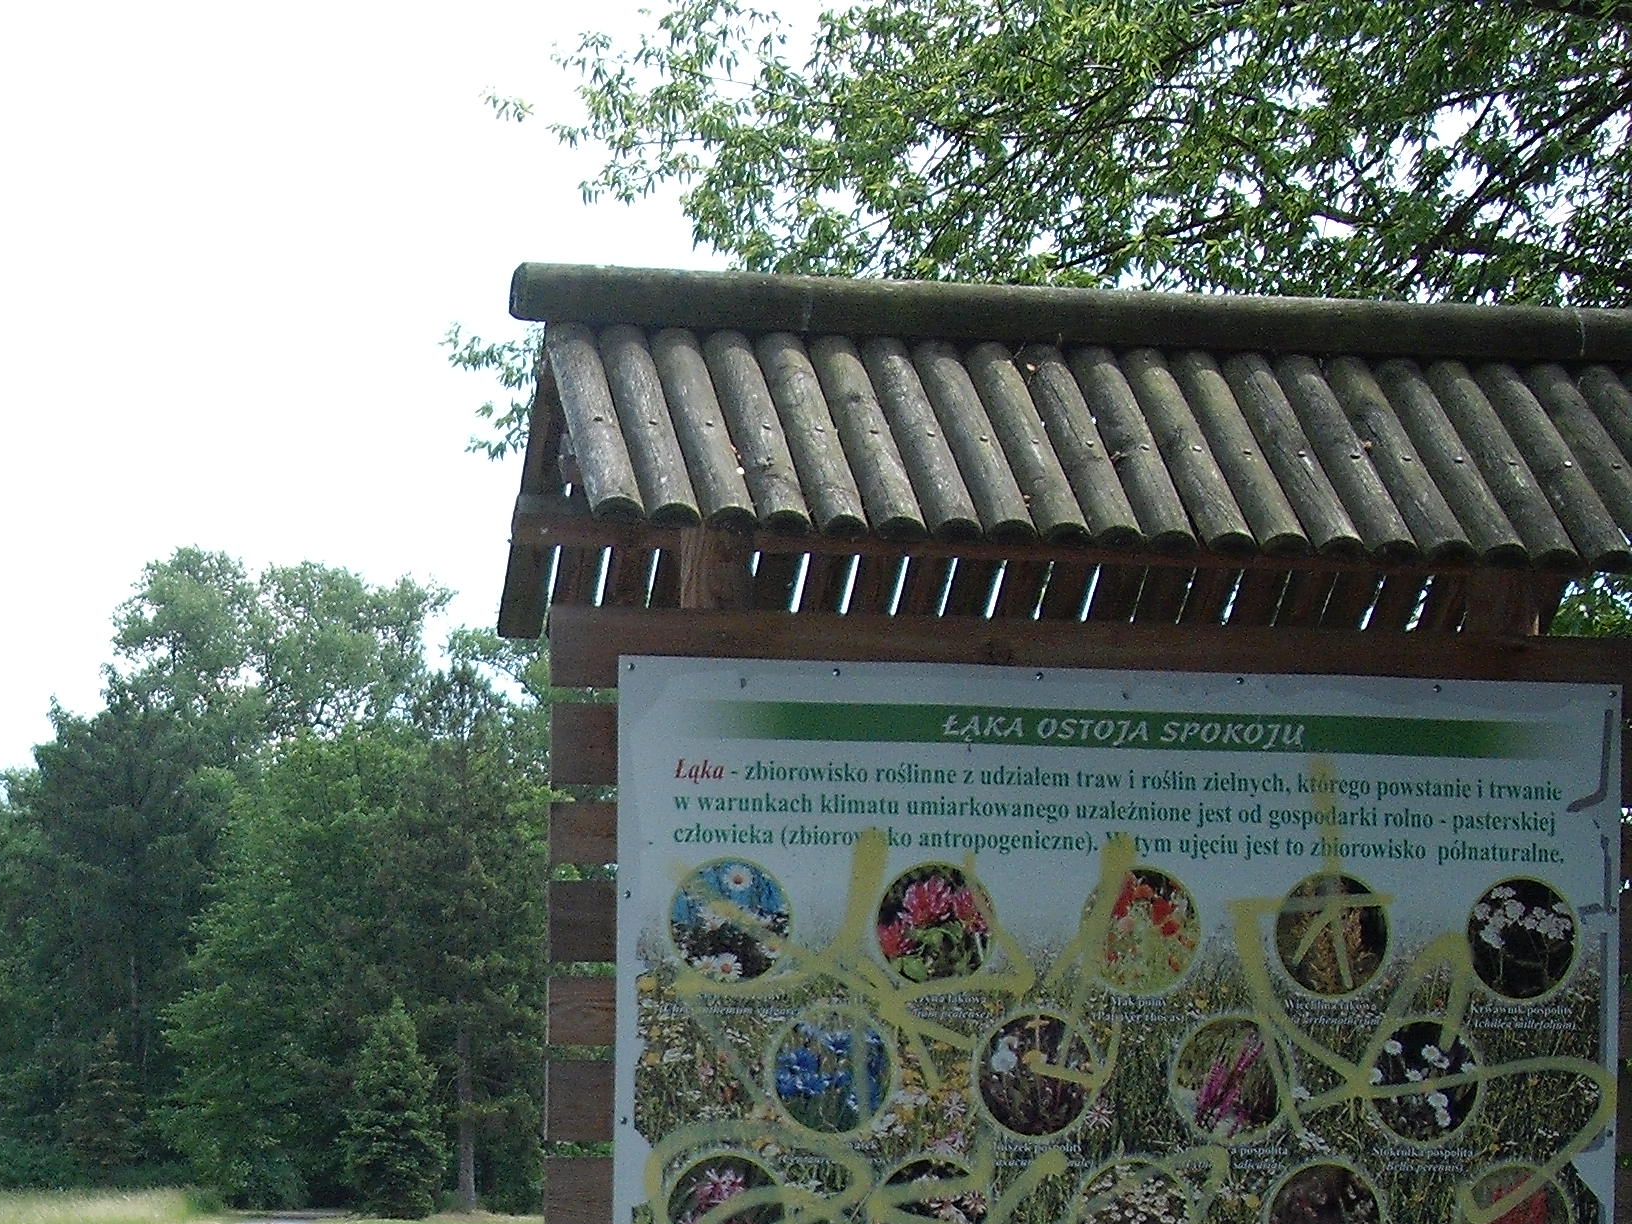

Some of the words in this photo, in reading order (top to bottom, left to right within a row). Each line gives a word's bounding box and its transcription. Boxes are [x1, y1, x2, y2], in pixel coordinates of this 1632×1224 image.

[941, 715, 1023, 745] ŁĄKA
[1037, 717, 1149, 746] OSTOJA
[1160, 721, 1306, 750] SPOKOJU
[675, 759, 724, 784] Łąka
[745, 761, 868, 782] zbiorowisko
[876, 762, 957, 784] roślinne
[963, 770, 974, 784] z
[981, 765, 1069, 787] udziałem
[1077, 771, 1120, 788] traw
[1129, 769, 1134, 789] i
[1142, 770, 1196, 791] roślin
[1203, 772, 1291, 797] zielnych,
[1298, 773, 1370, 799] którego
[1377, 778, 1471, 801] powstanie
[1477, 779, 1482, 798] i
[1490, 781, 1562, 801] trwanie
[674, 796, 689, 810] w
[698, 792, 812, 813] warunkach
[821, 794, 898, 814] klimatu
[907, 796, 1069, 823] umiarkowanego
[1076, 800, 1191, 823] uzależnione
[1197, 802, 1231, 828] jest
[1238, 804, 1261, 823] od
[1269, 806, 1377, 830] gospodarki
[1385, 808, 1433, 828] rolno
[1453, 811, 1555, 837] pasterskiej
[674, 823, 773, 844] człowieka
[918, 831, 1098, 854] antropogeniczne).
[1135, 836, 1172, 857] tym
[1179, 837, 1239, 860] ujęciu
[1244, 836, 1280, 858] jest
[1285, 837, 1305, 857] to
[1310, 837, 1427, 860] zbiorowisko
